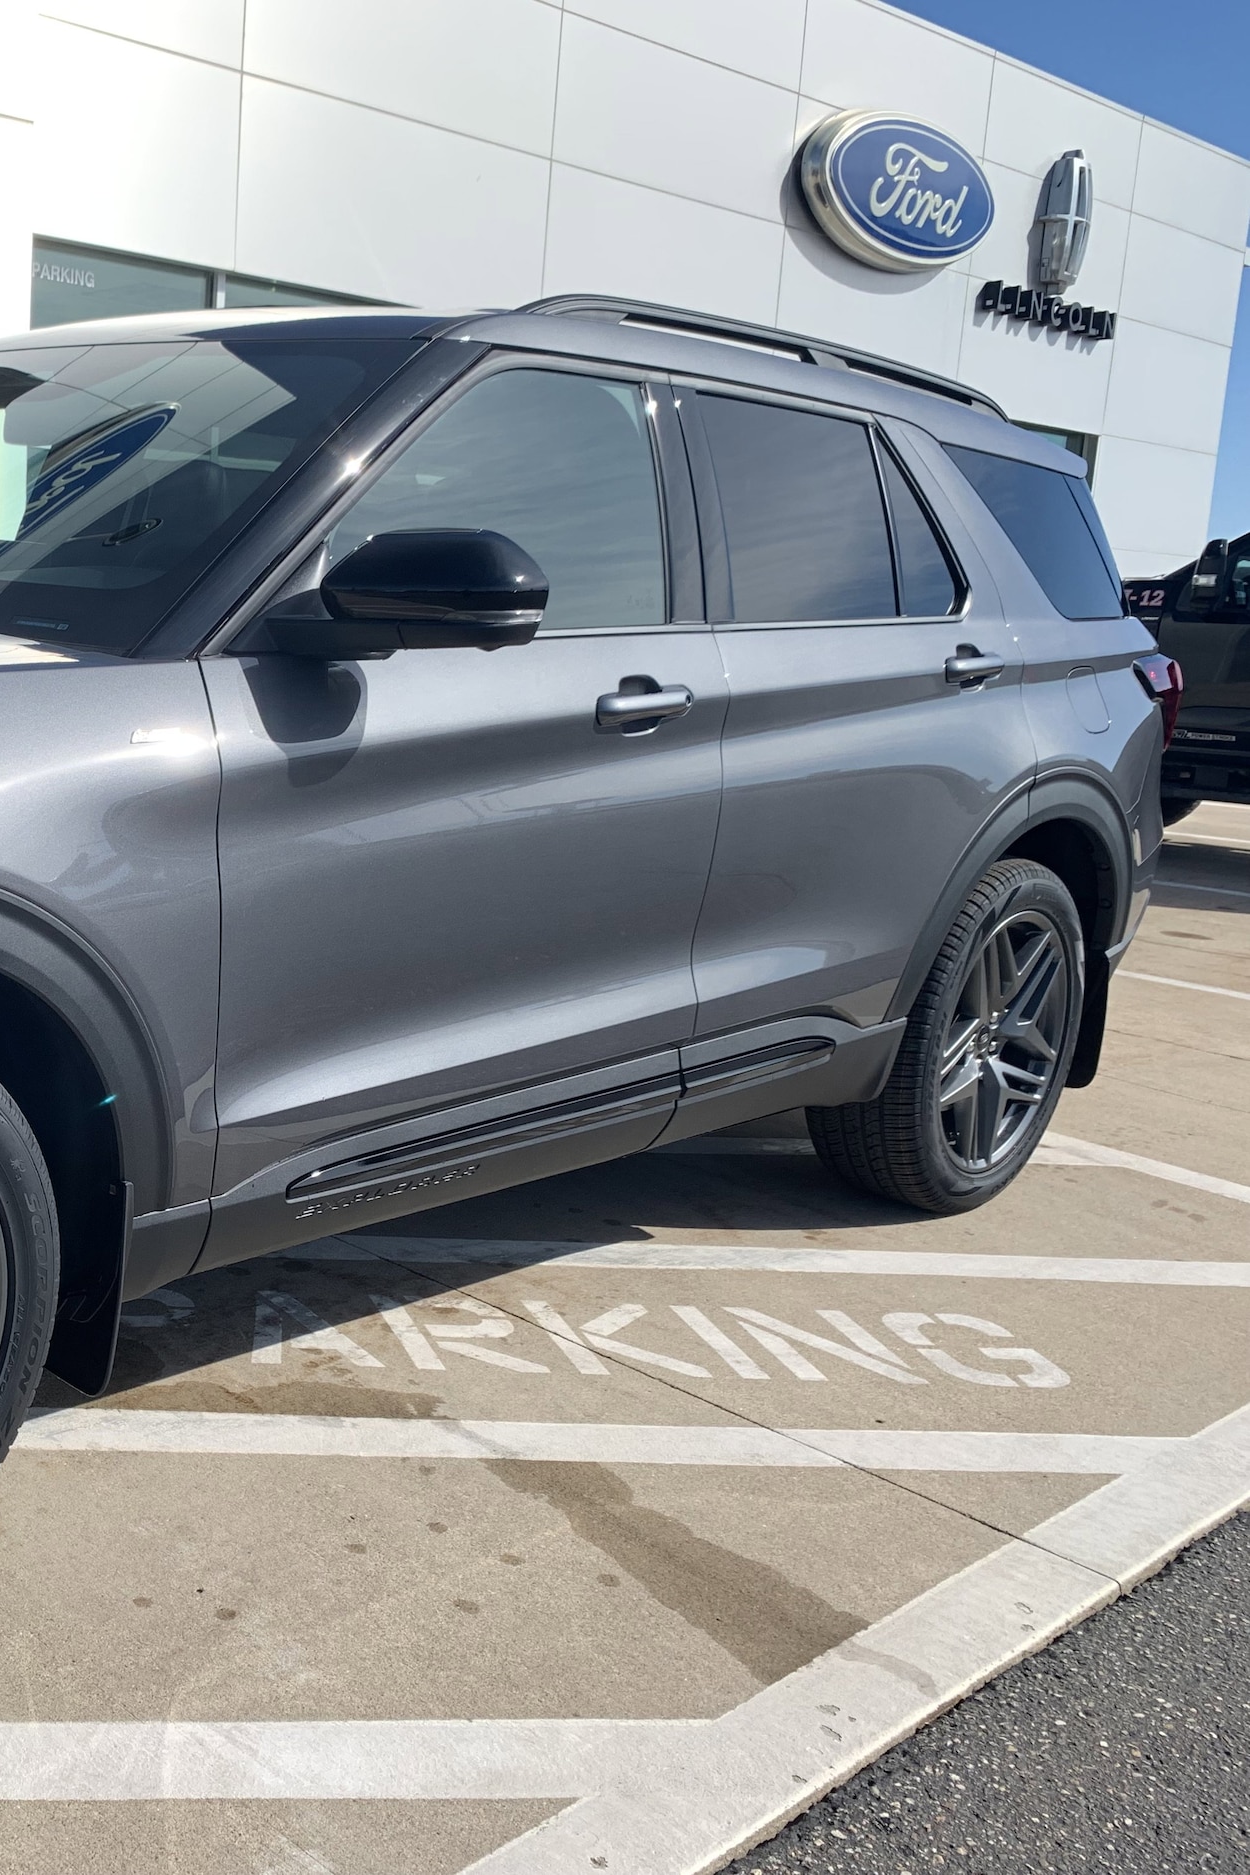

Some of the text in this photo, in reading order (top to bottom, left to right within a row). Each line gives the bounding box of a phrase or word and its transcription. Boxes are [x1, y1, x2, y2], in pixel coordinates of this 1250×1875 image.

[870, 142, 968, 237] Ford
[32, 262, 95, 288] PARKING
[993, 280, 1117, 340] LINCOLN
[18, 1192, 49, 1396] SCORPION
